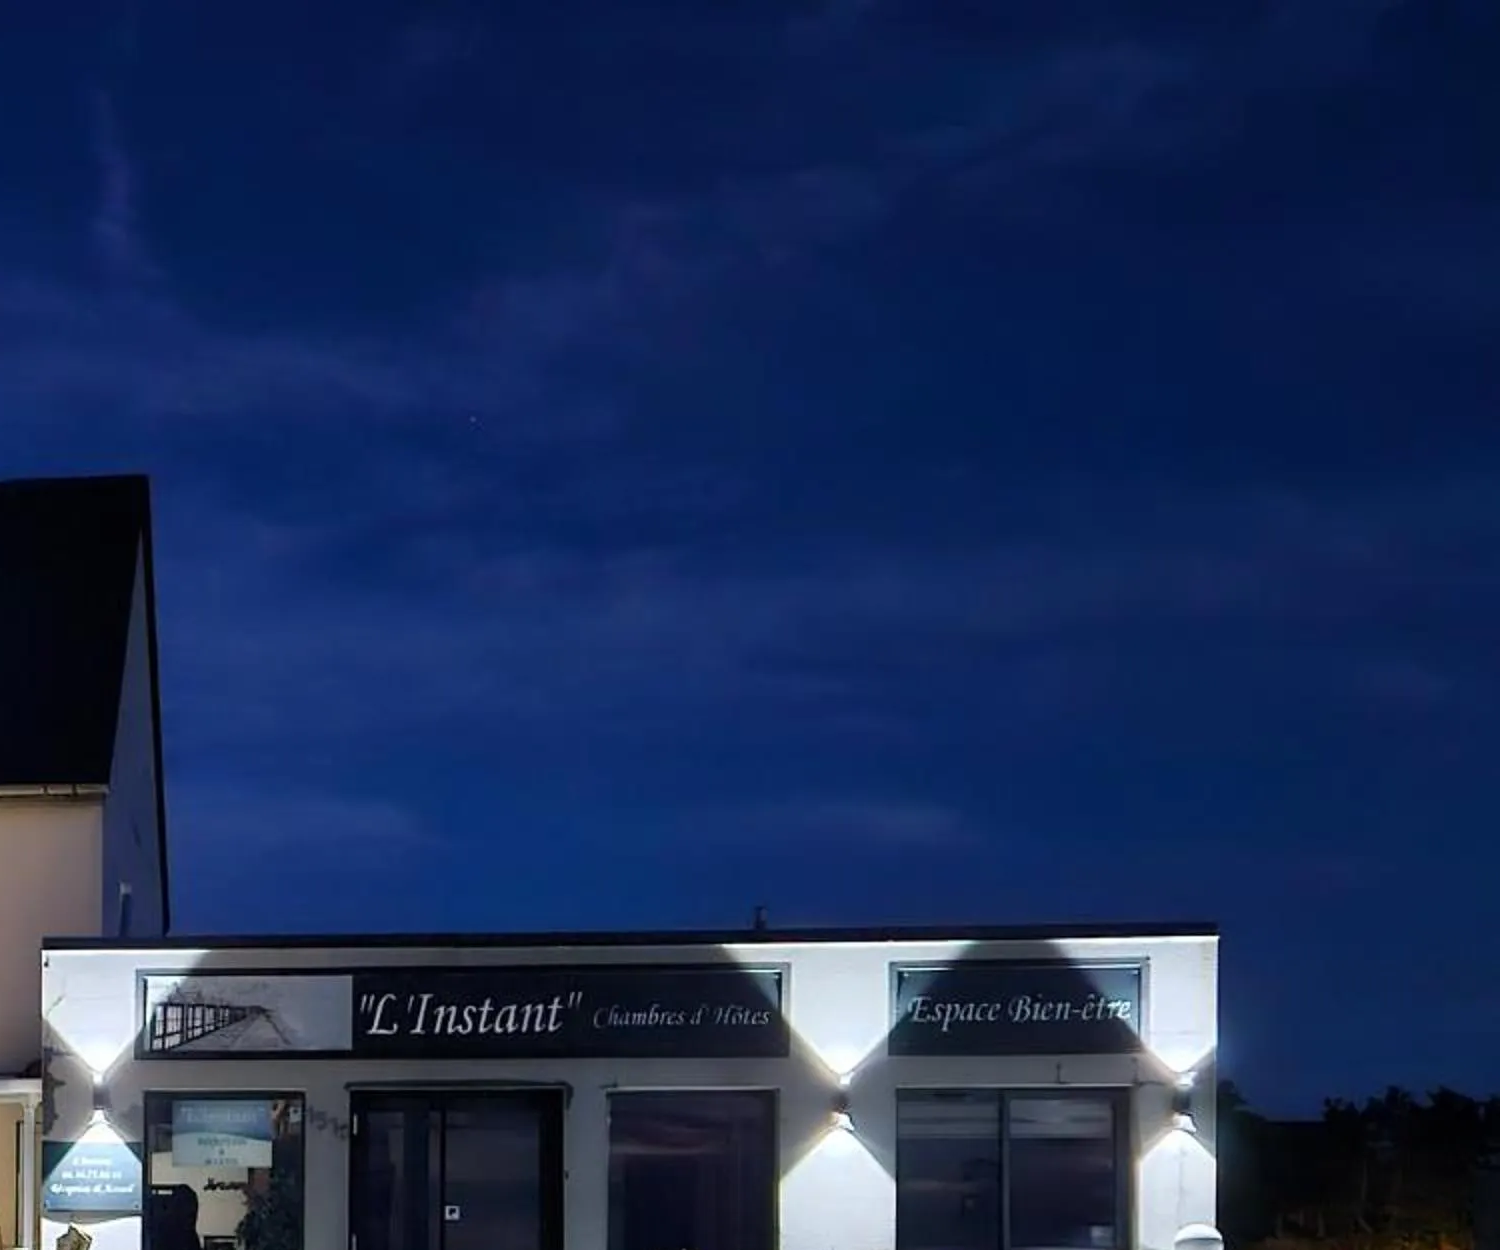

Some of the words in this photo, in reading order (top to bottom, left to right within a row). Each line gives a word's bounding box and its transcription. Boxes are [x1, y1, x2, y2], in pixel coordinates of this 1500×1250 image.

[592, 1003, 685, 1029] Chambres
[908, 995, 1000, 1032] Espace
[1007, 993, 1132, 1022] Bien-être
